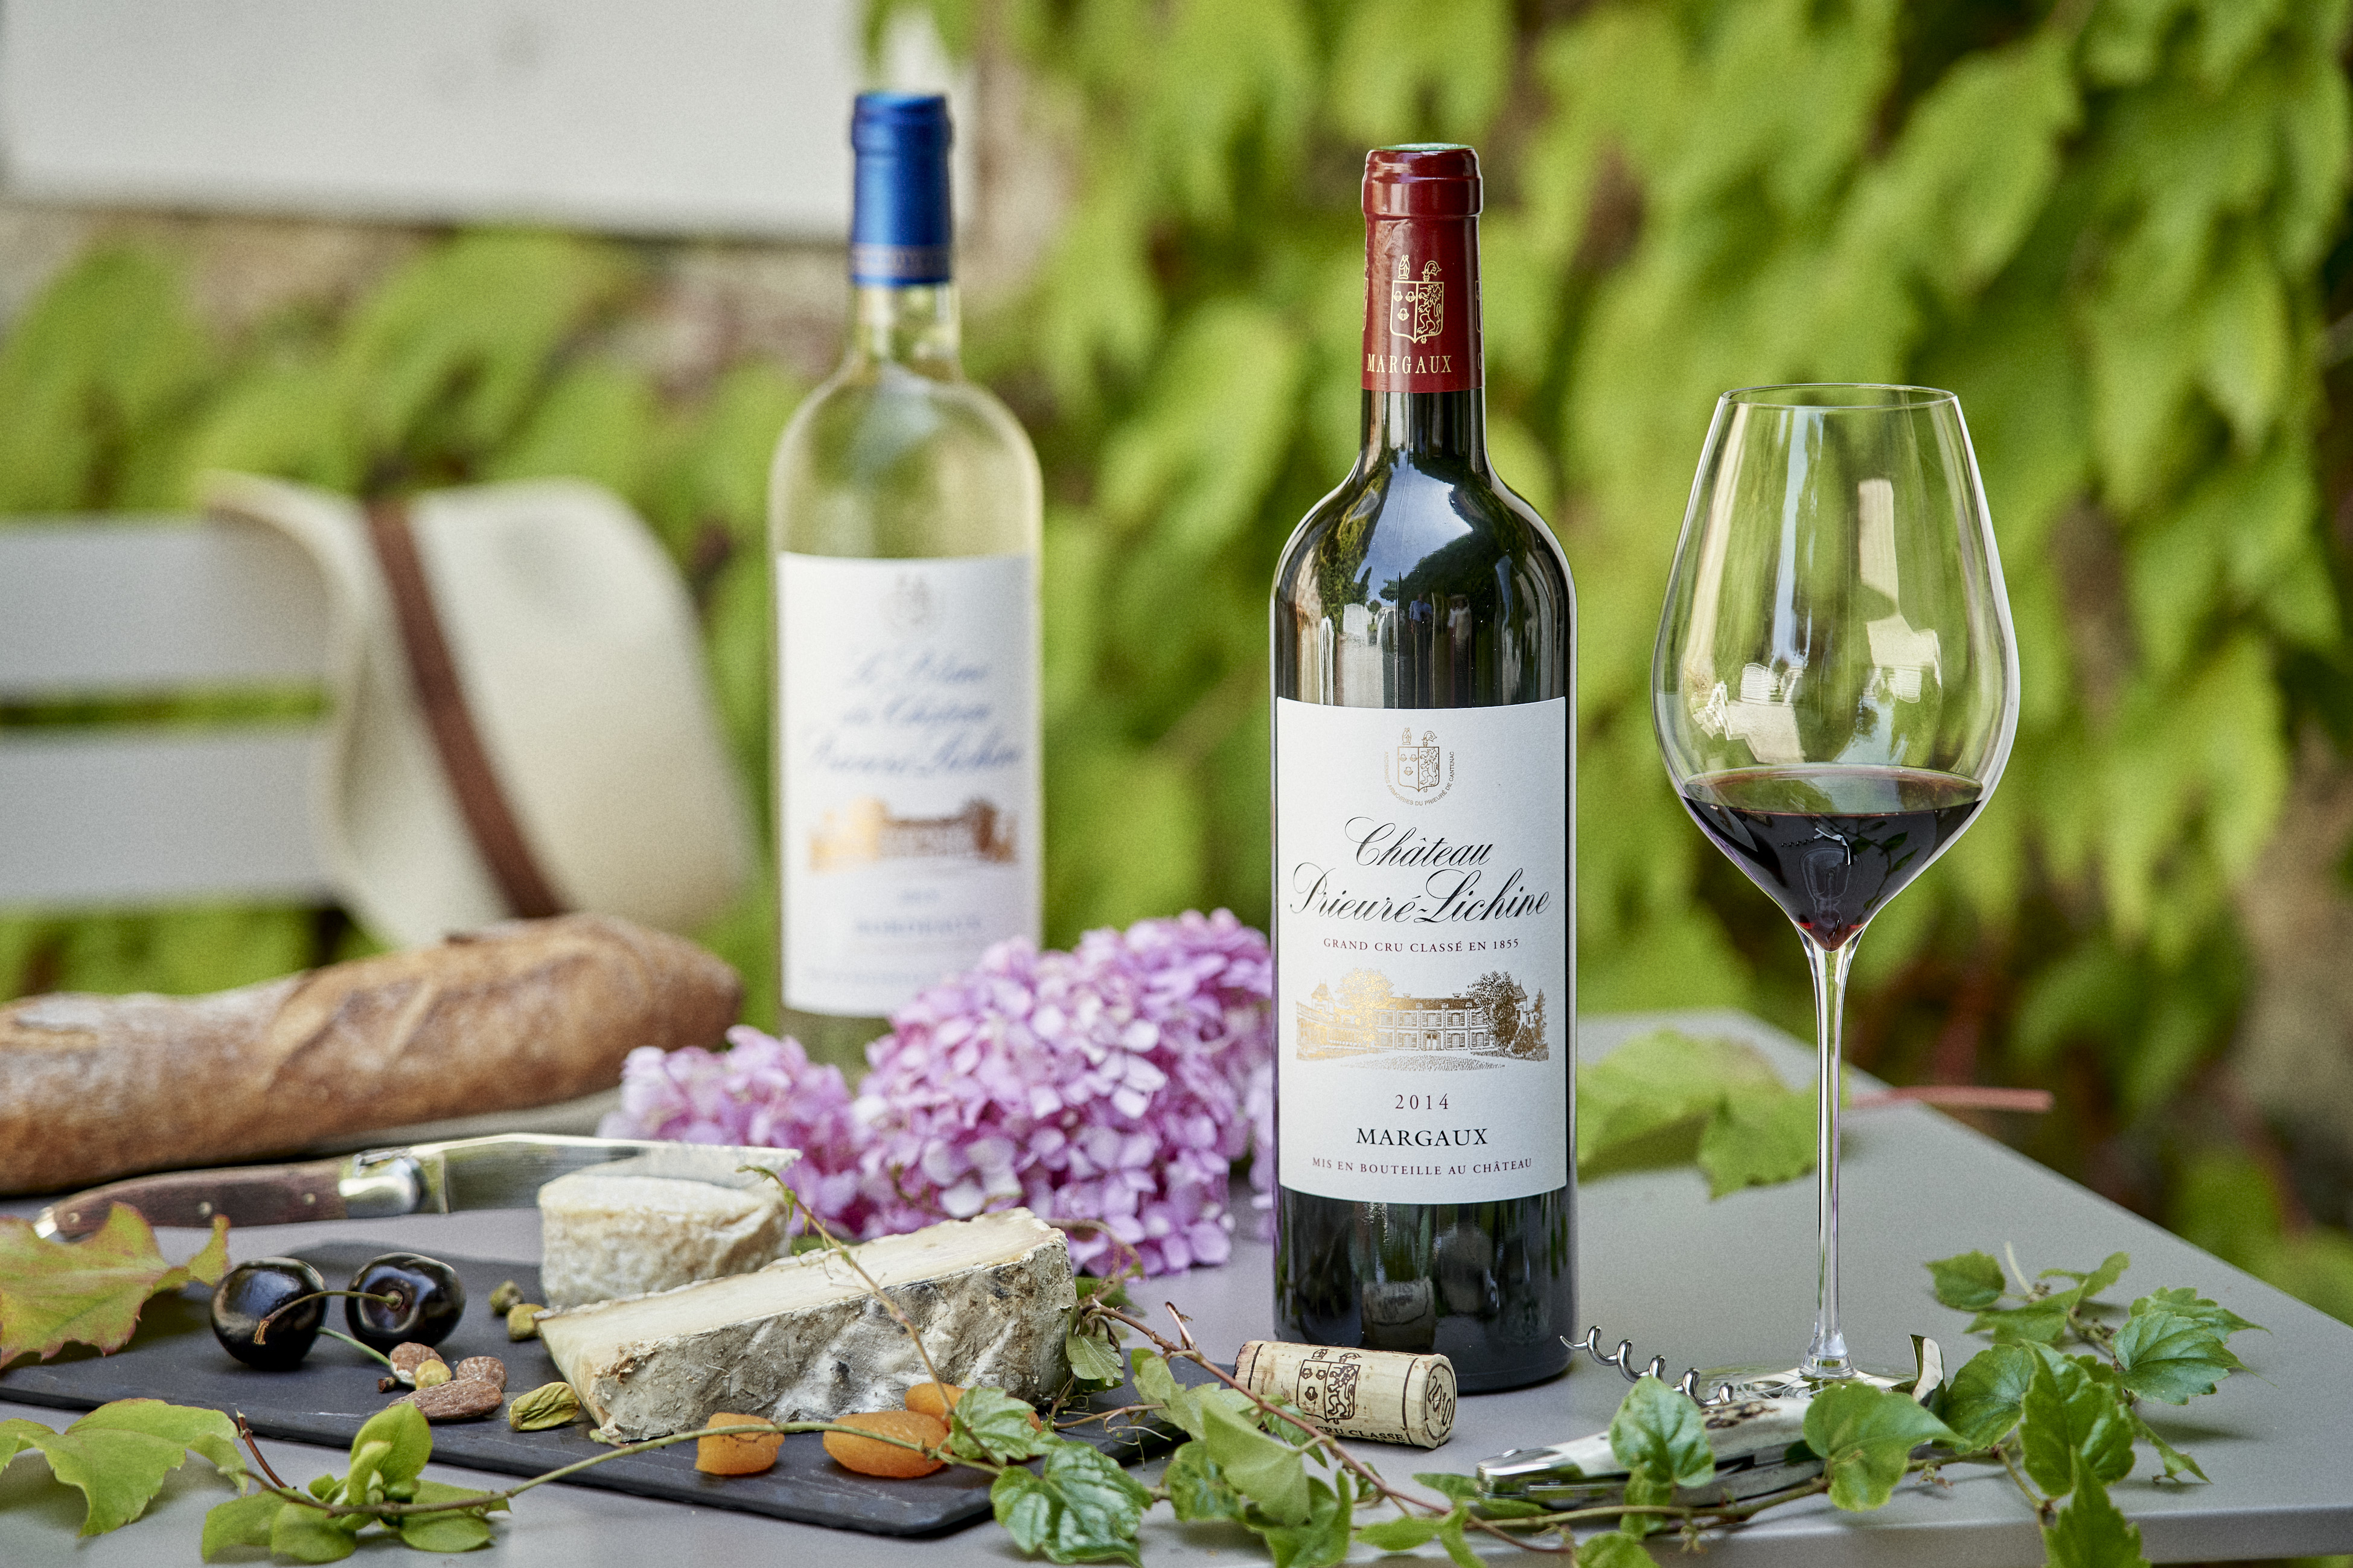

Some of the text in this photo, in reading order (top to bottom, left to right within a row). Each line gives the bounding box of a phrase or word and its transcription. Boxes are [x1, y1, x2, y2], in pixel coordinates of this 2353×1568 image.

[1367, 354, 1452, 374] MARGAUX
[1387, 785, 1414, 806] ARMOIRIES
[1425, 789, 1448, 806] PRIEURÉ
[1445, 782, 1453, 791] DE
[1344, 817, 1493, 867] Château
[1323, 938, 1519, 953] GRAND CRU CLASSÉ EN 1855
[1394, 1093, 1449, 1111] 2014
[1356, 1127, 1489, 1147] MARGAUX
[1312, 1157, 1533, 1176] MIS EN BOUTEILLE AU CHÂTEAU
